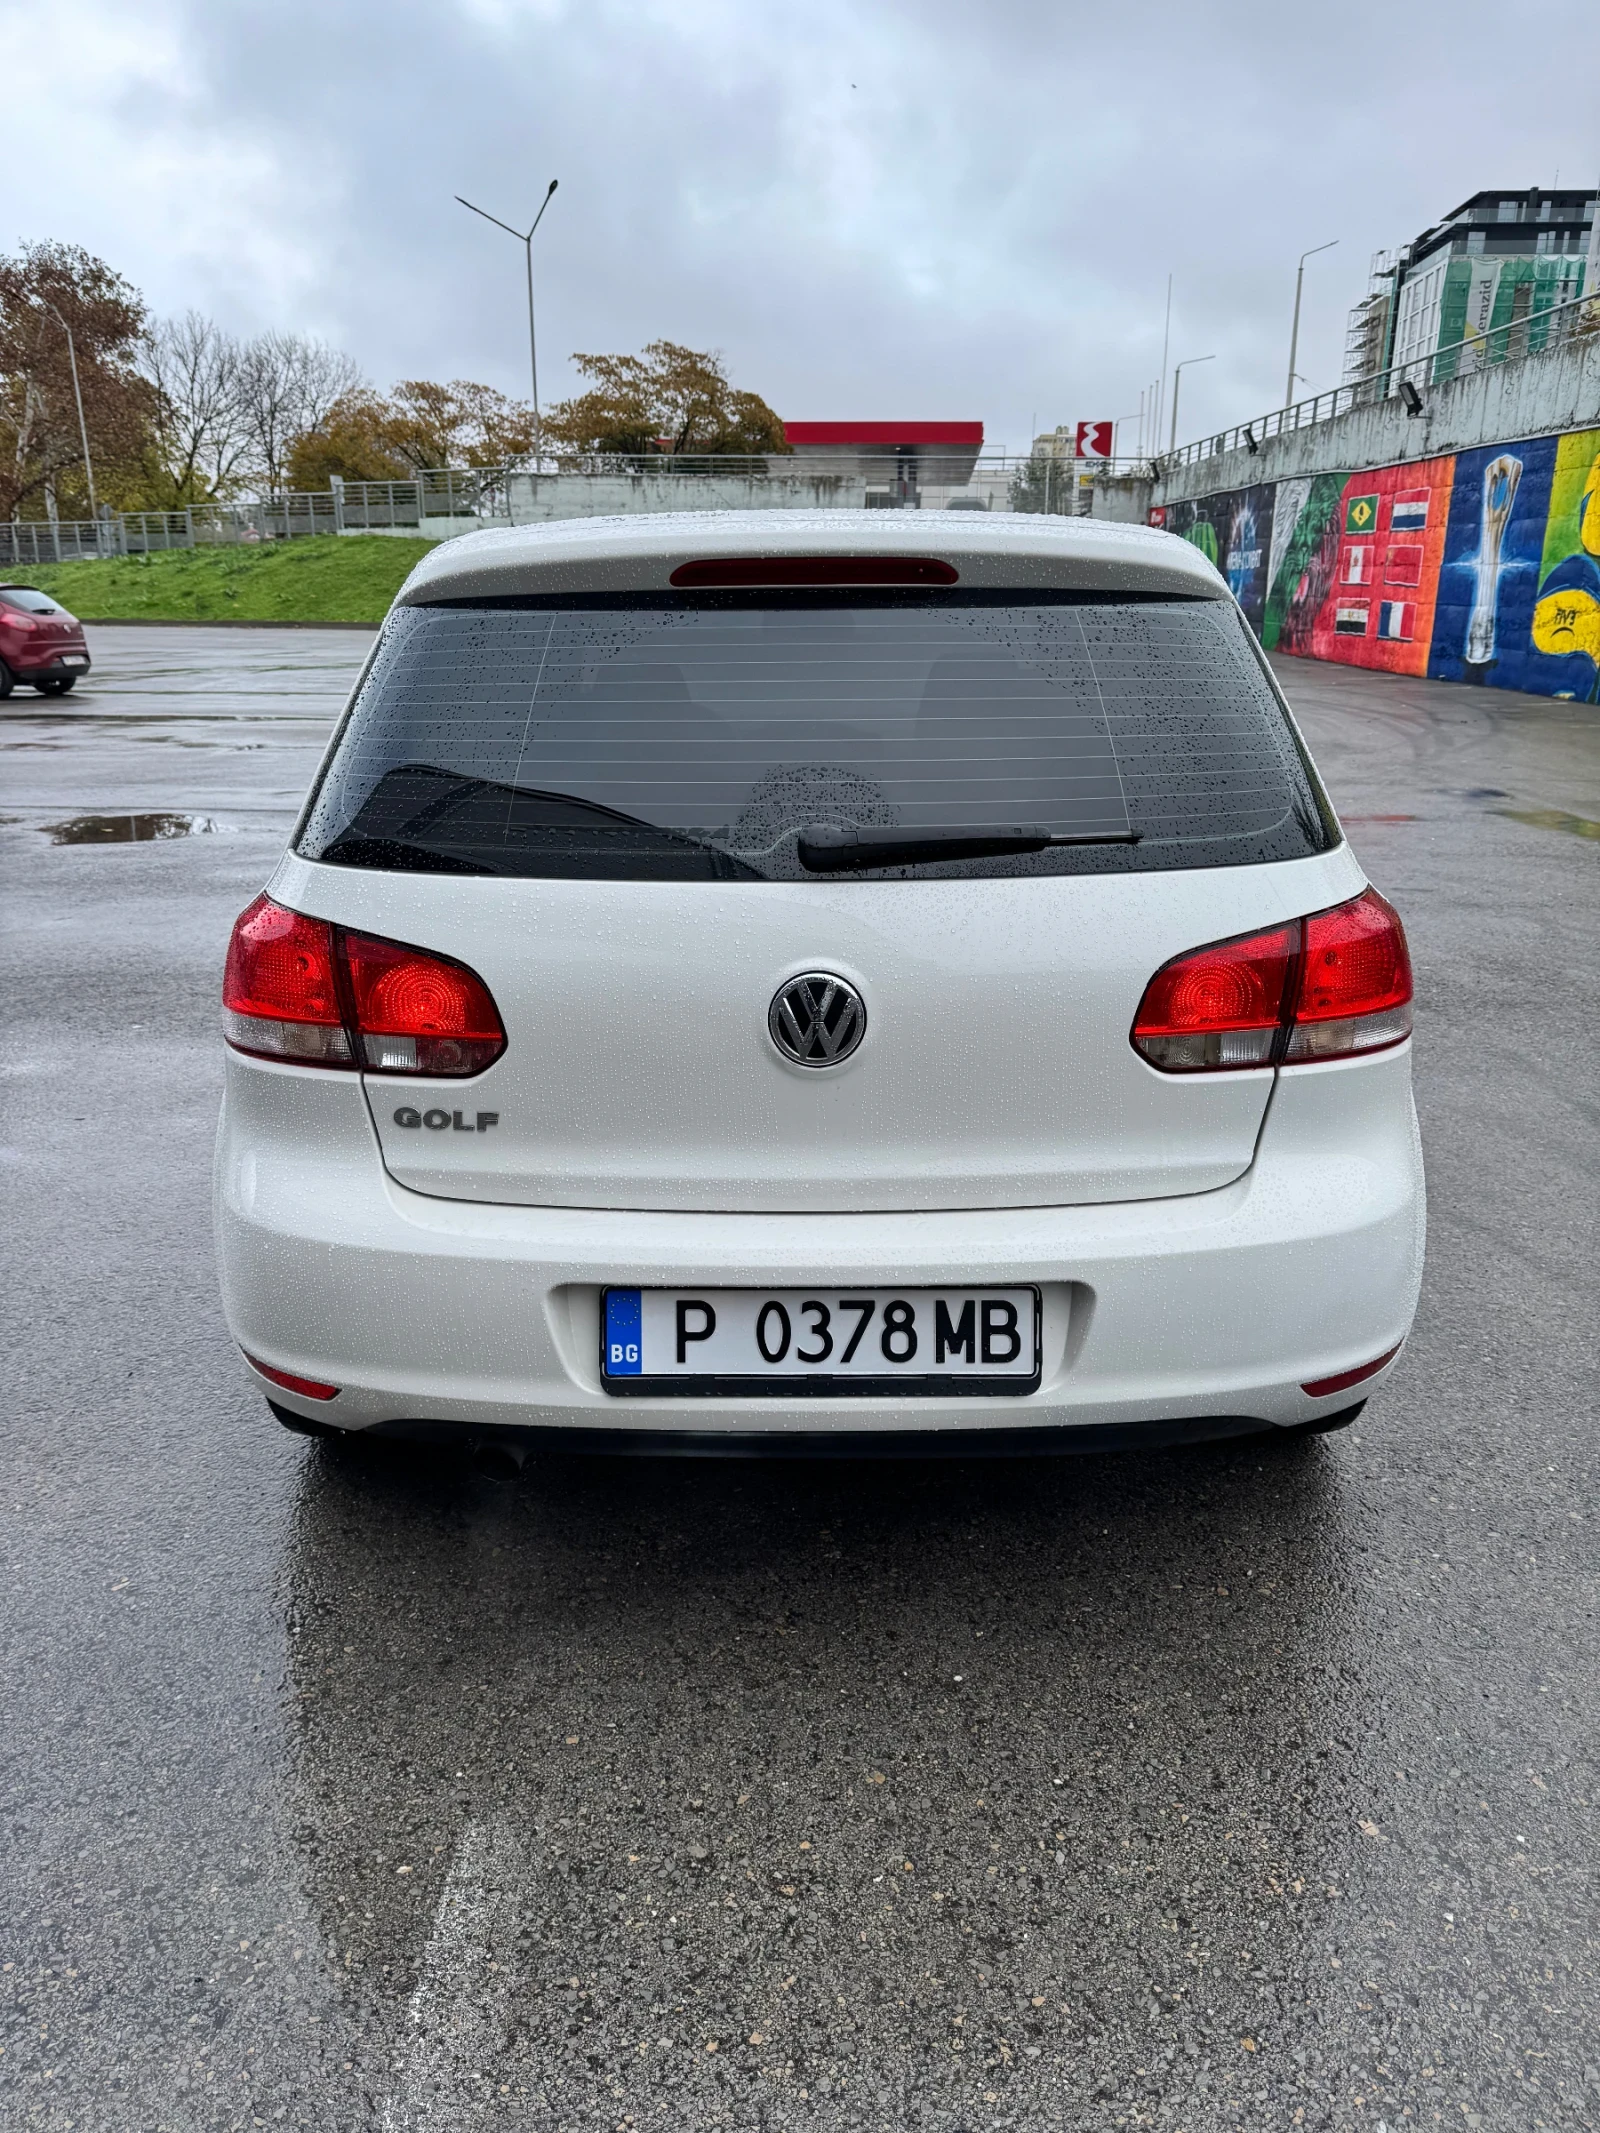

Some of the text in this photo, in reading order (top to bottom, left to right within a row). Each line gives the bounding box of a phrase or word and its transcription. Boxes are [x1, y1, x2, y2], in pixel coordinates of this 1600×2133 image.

[393, 1106, 500, 1132] GOLF
[675, 1299, 1022, 1364] P 0378 MB
[611, 1343, 639, 1364] BG
